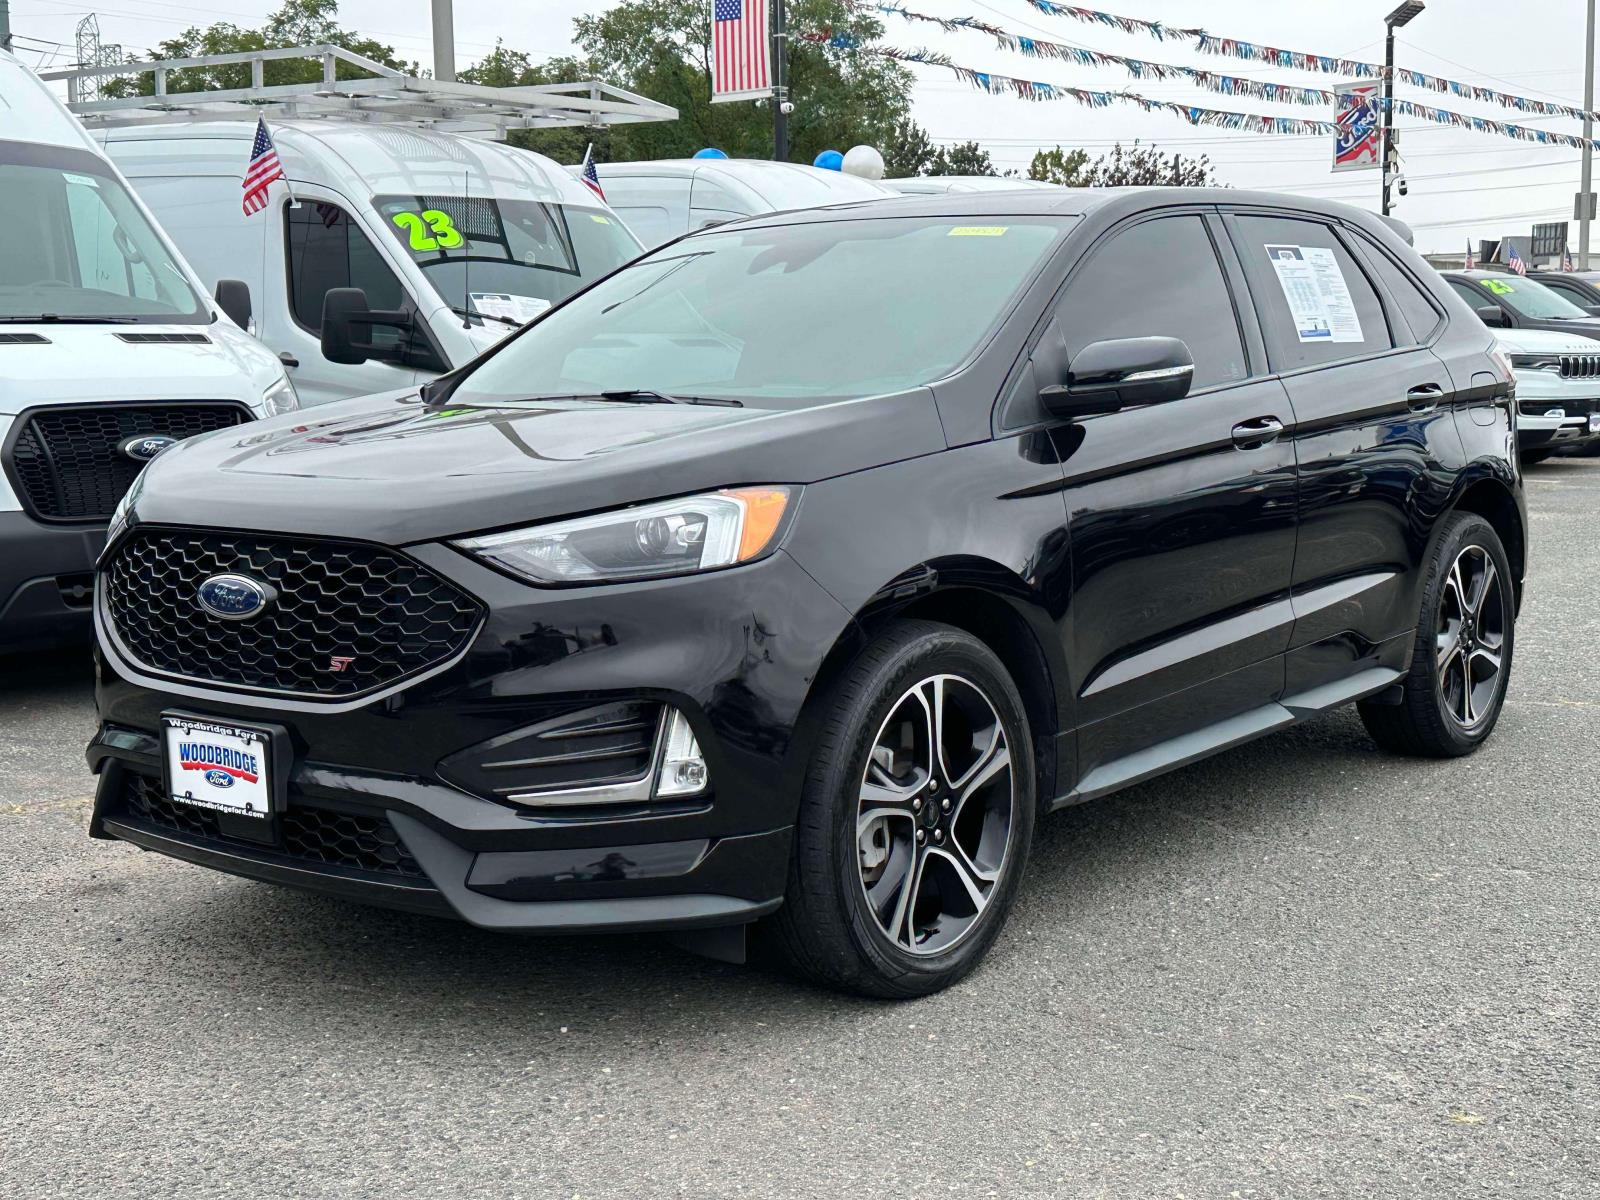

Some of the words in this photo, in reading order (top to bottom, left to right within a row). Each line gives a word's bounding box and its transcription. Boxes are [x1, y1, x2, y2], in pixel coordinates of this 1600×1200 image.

[392, 209, 464, 251] 23
[211, 583, 248, 608] Ford
[329, 656, 356, 672] ST
[169, 719, 232, 736] Woodbridge
[235, 728, 257, 741] Ford
[179, 743, 258, 775] WOODBRIDGE
[209, 771, 229, 786] Ford
[173, 796, 265, 818] www.woodbridgeford.com
